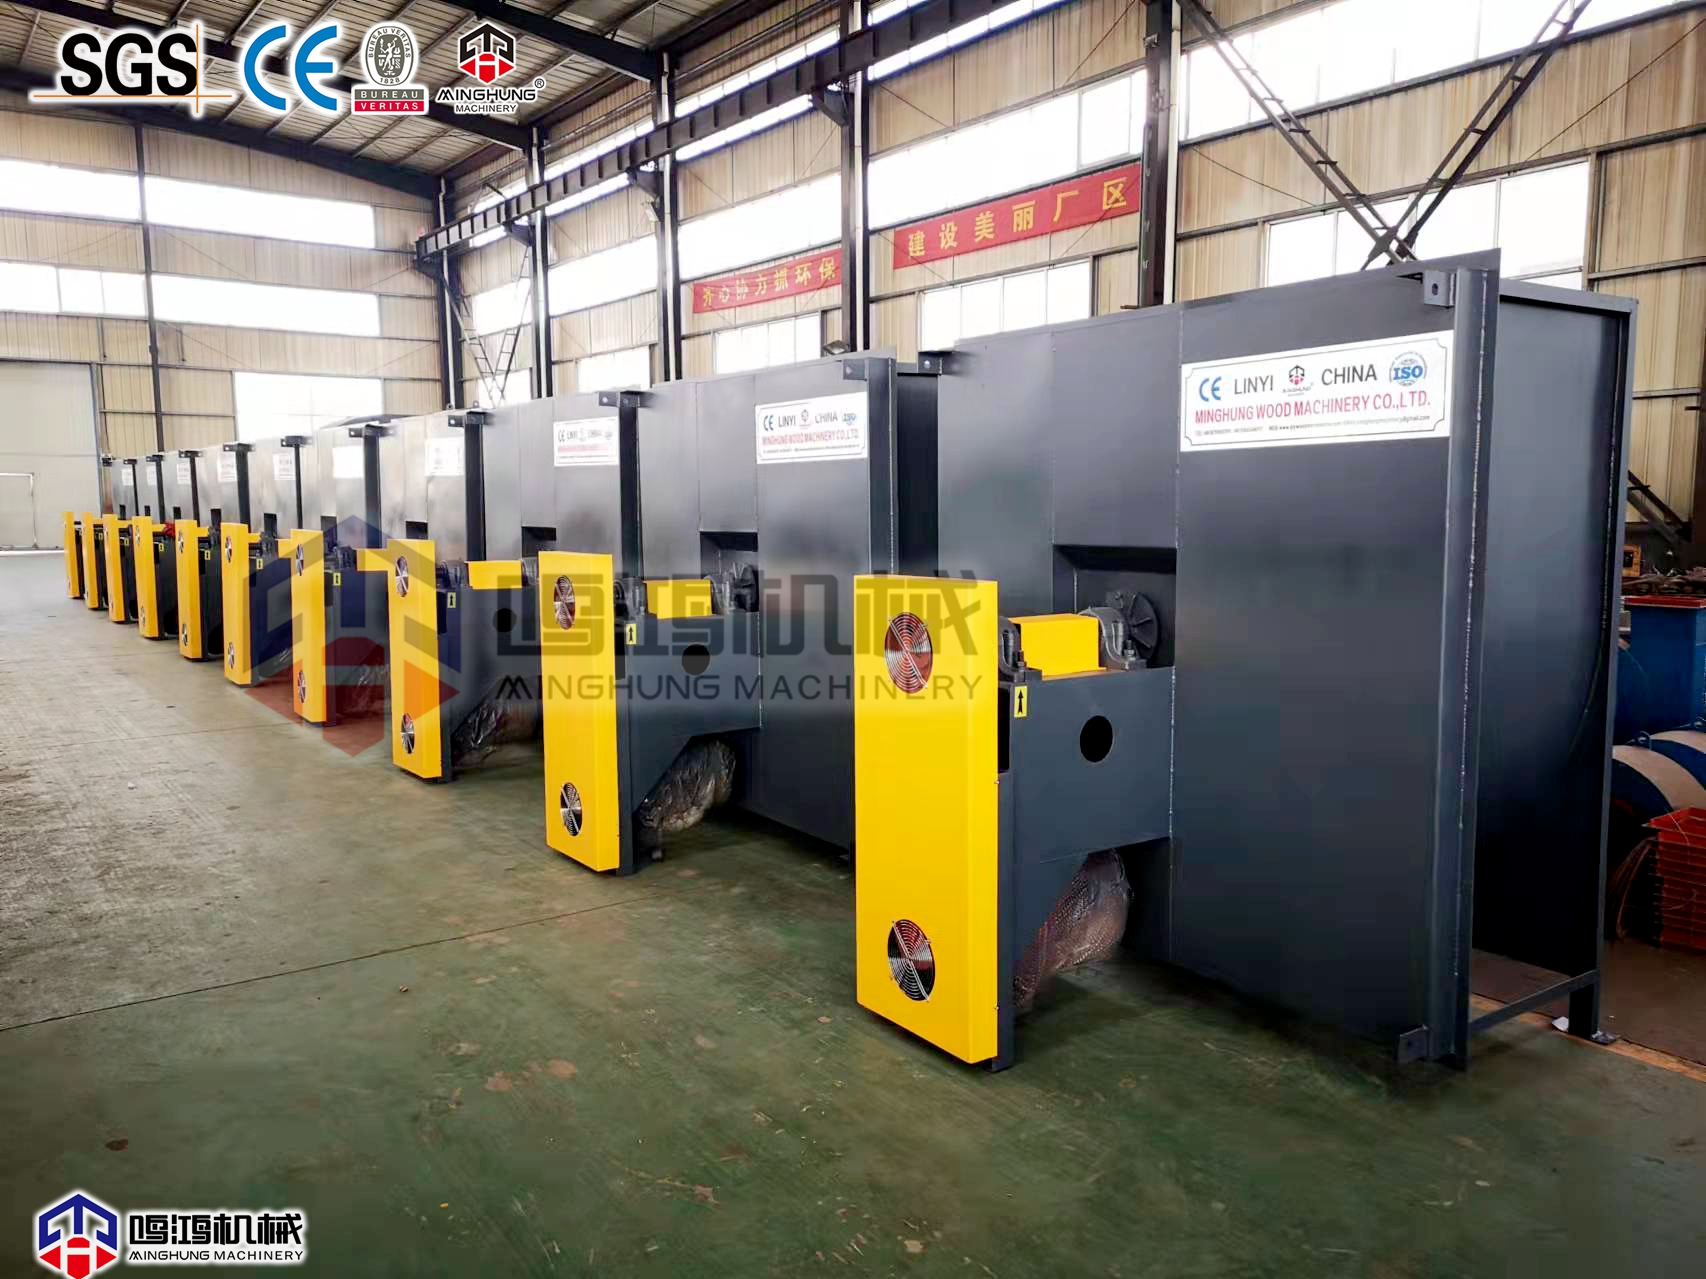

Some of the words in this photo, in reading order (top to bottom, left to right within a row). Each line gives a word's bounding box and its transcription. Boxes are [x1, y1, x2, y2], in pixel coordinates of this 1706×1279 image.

[907, 177, 1128, 258] 建设美丽厂区
[1199, 376, 1222, 402] CE
[1234, 375, 1274, 395] LINYI
[1321, 364, 1377, 386] CHINA
[1392, 365, 1424, 380] ISO
[763, 414, 774, 431] CE
[778, 415, 796, 428] LINYI
[1195, 406, 1254, 424] MINGHUNG
[1256, 402, 1292, 419] WOOD
[1294, 395, 1370, 417] MACHINERY
